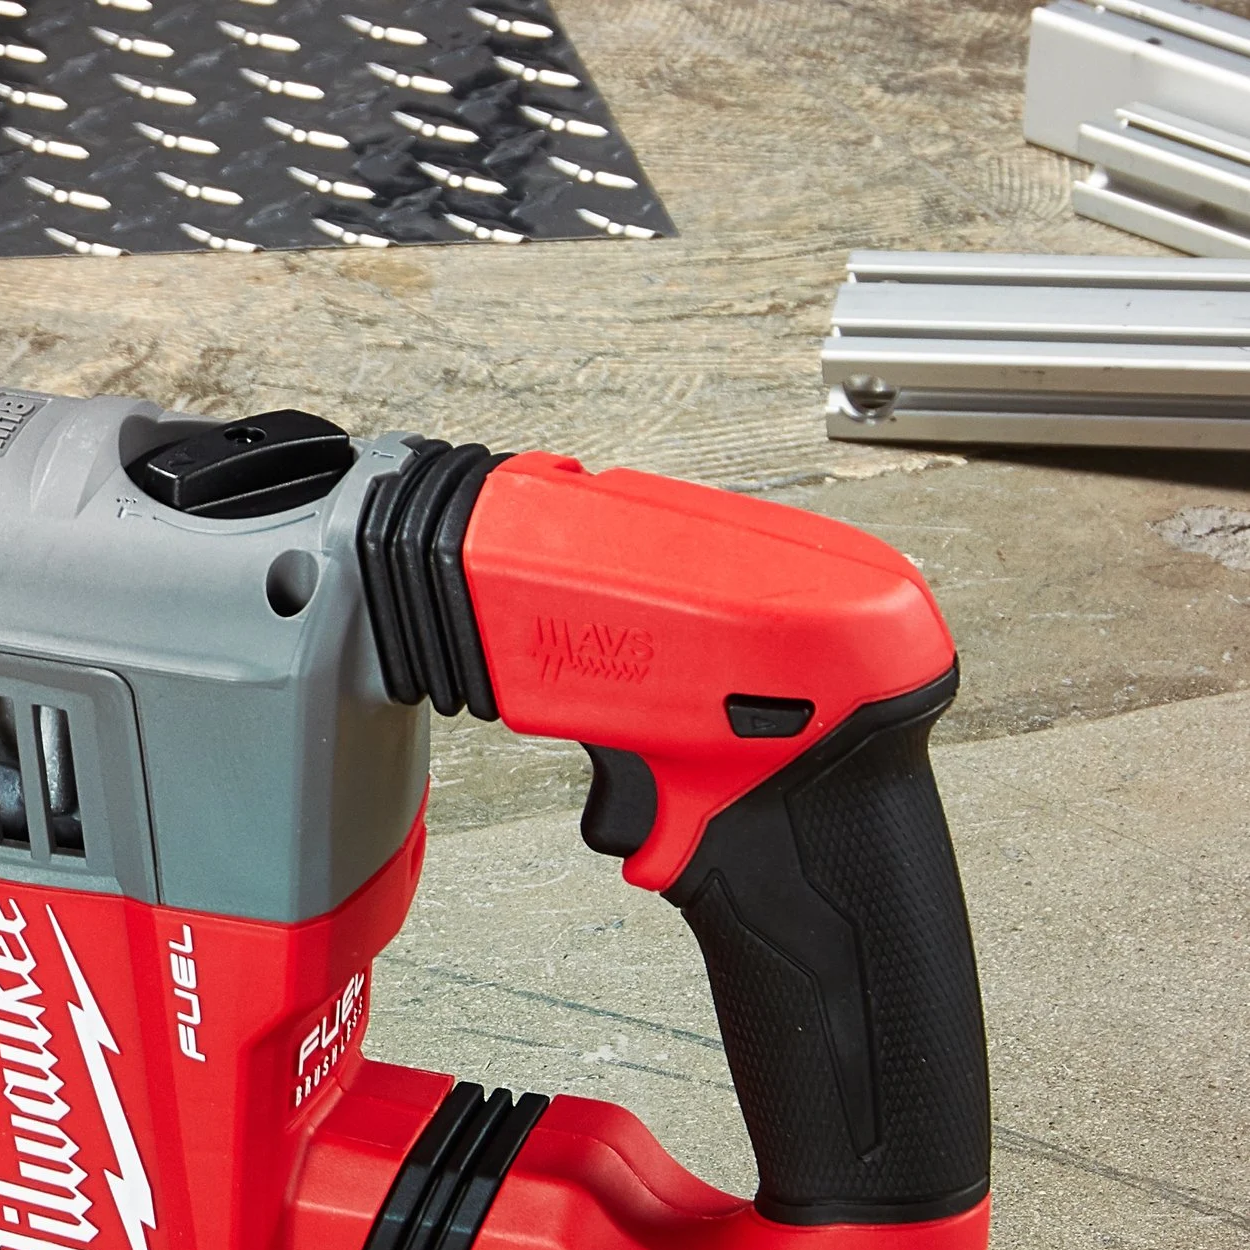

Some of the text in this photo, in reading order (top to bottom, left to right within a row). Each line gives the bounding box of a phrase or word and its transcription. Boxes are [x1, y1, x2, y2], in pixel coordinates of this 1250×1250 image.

[577, 622, 655, 662] AVS
[168, 923, 206, 1062] FUEL
[298, 972, 365, 1076] FUEL
